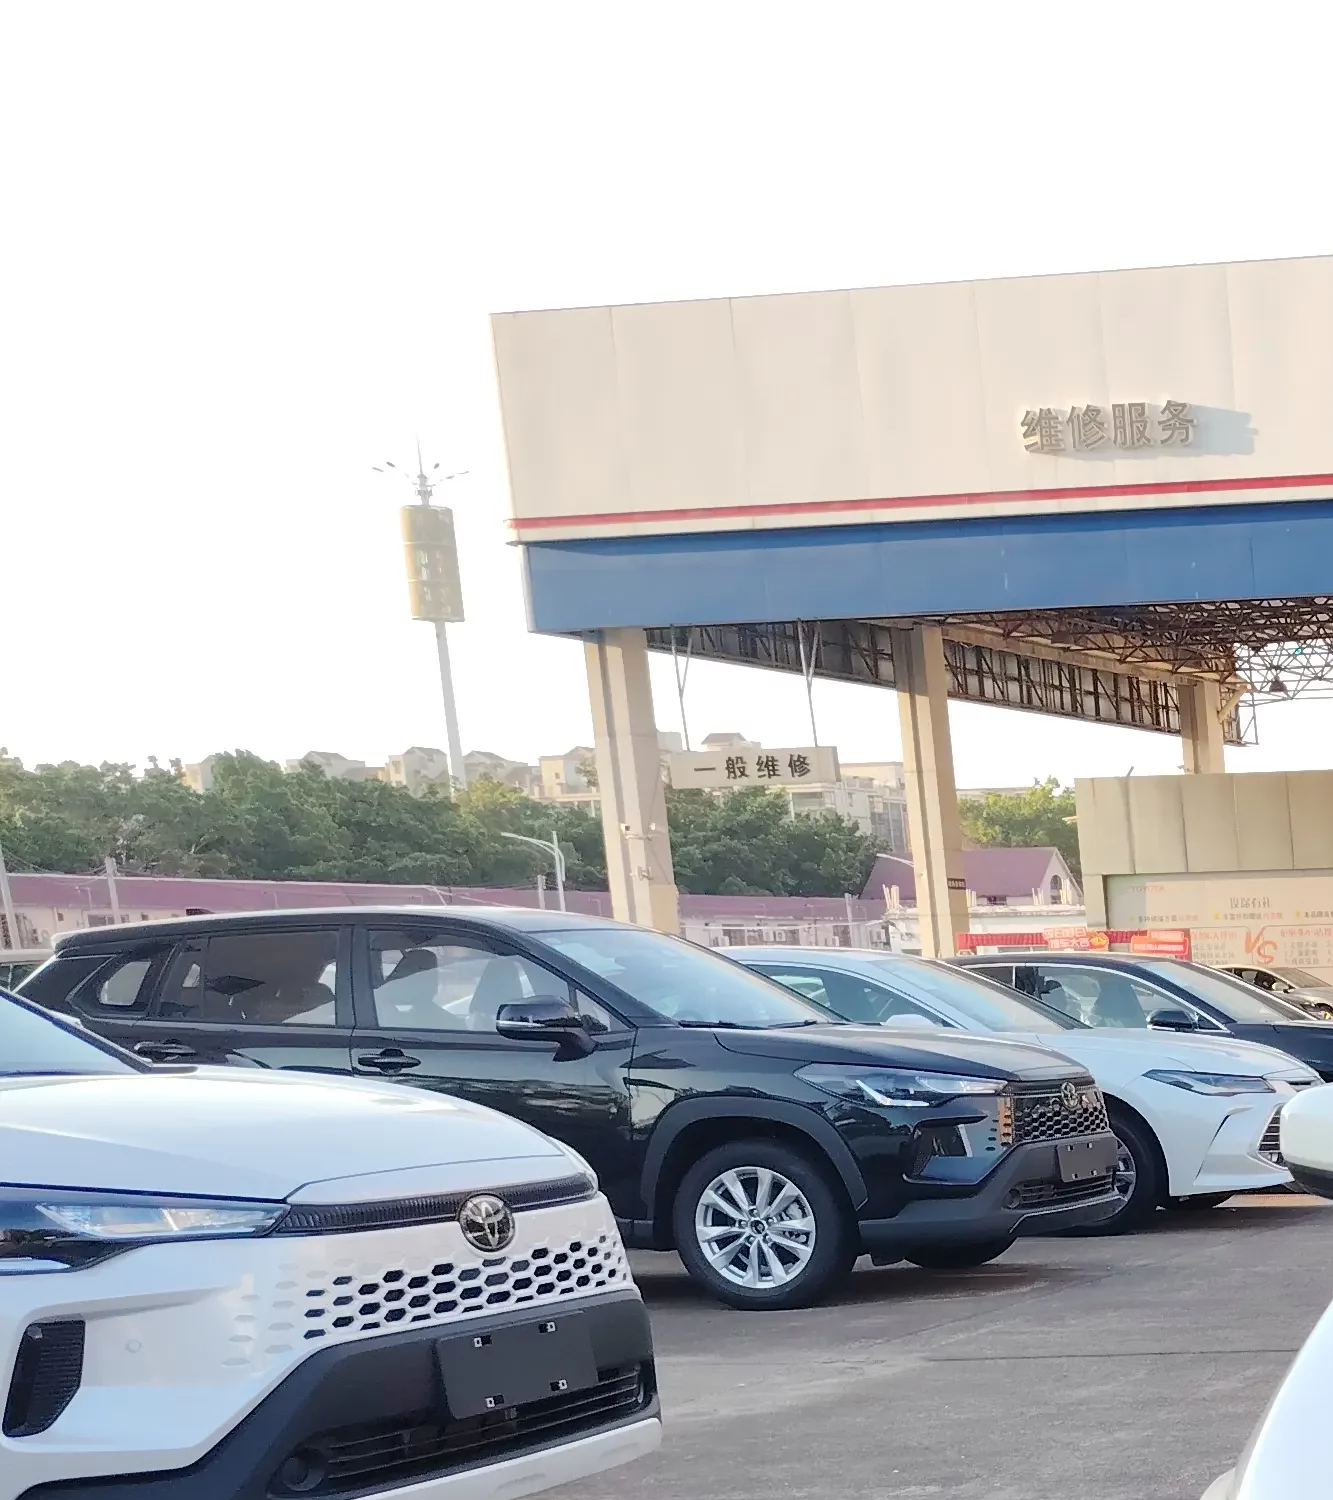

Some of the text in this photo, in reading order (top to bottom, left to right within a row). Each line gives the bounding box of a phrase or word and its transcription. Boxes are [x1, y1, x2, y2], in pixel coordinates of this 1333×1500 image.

[1021, 399, 1198, 454] 维修服务
[693, 753, 813, 780] 一般维修
